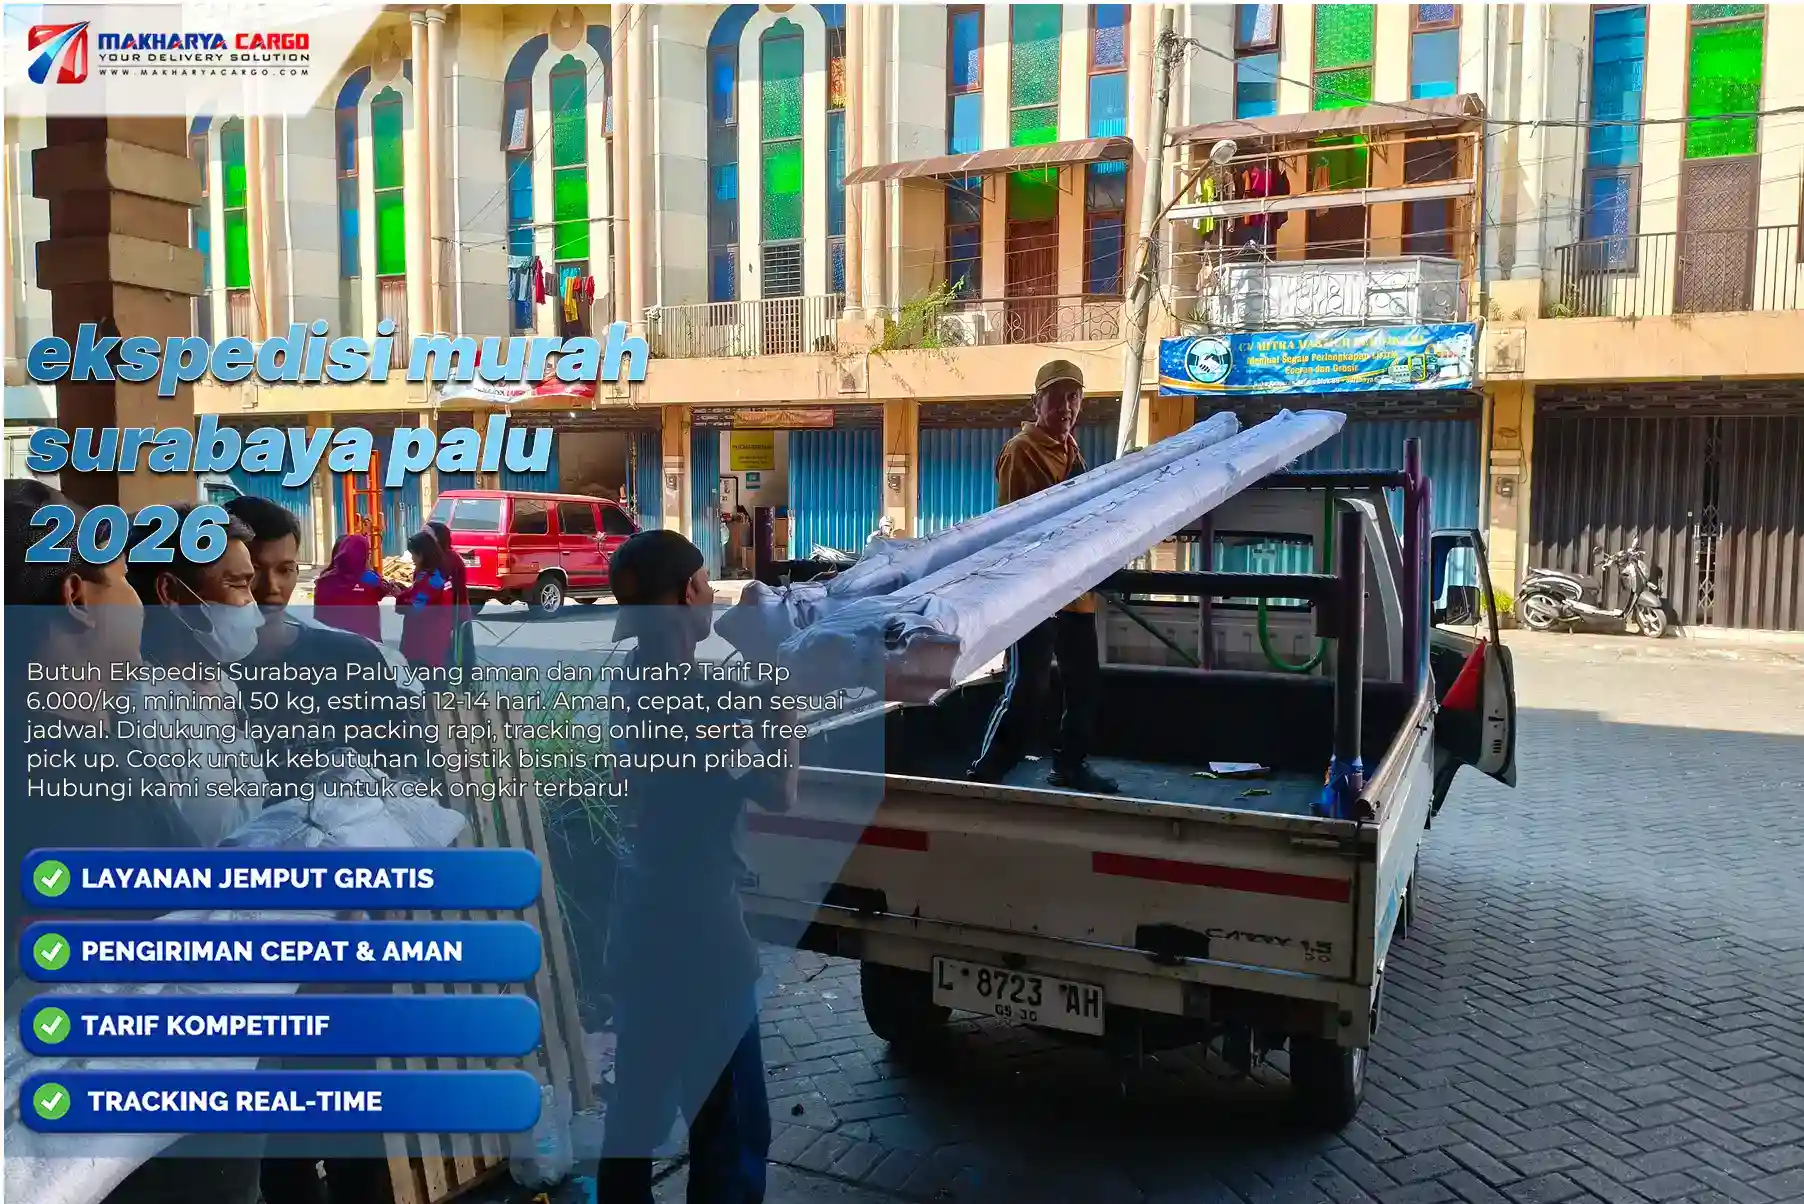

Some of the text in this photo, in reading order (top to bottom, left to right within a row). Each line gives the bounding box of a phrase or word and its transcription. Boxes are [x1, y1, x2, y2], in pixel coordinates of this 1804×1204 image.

[1315, 364, 1331, 373] dan
[1333, 363, 1359, 373] Grosir
[938, 961, 1099, 1018] L 8723 AH
